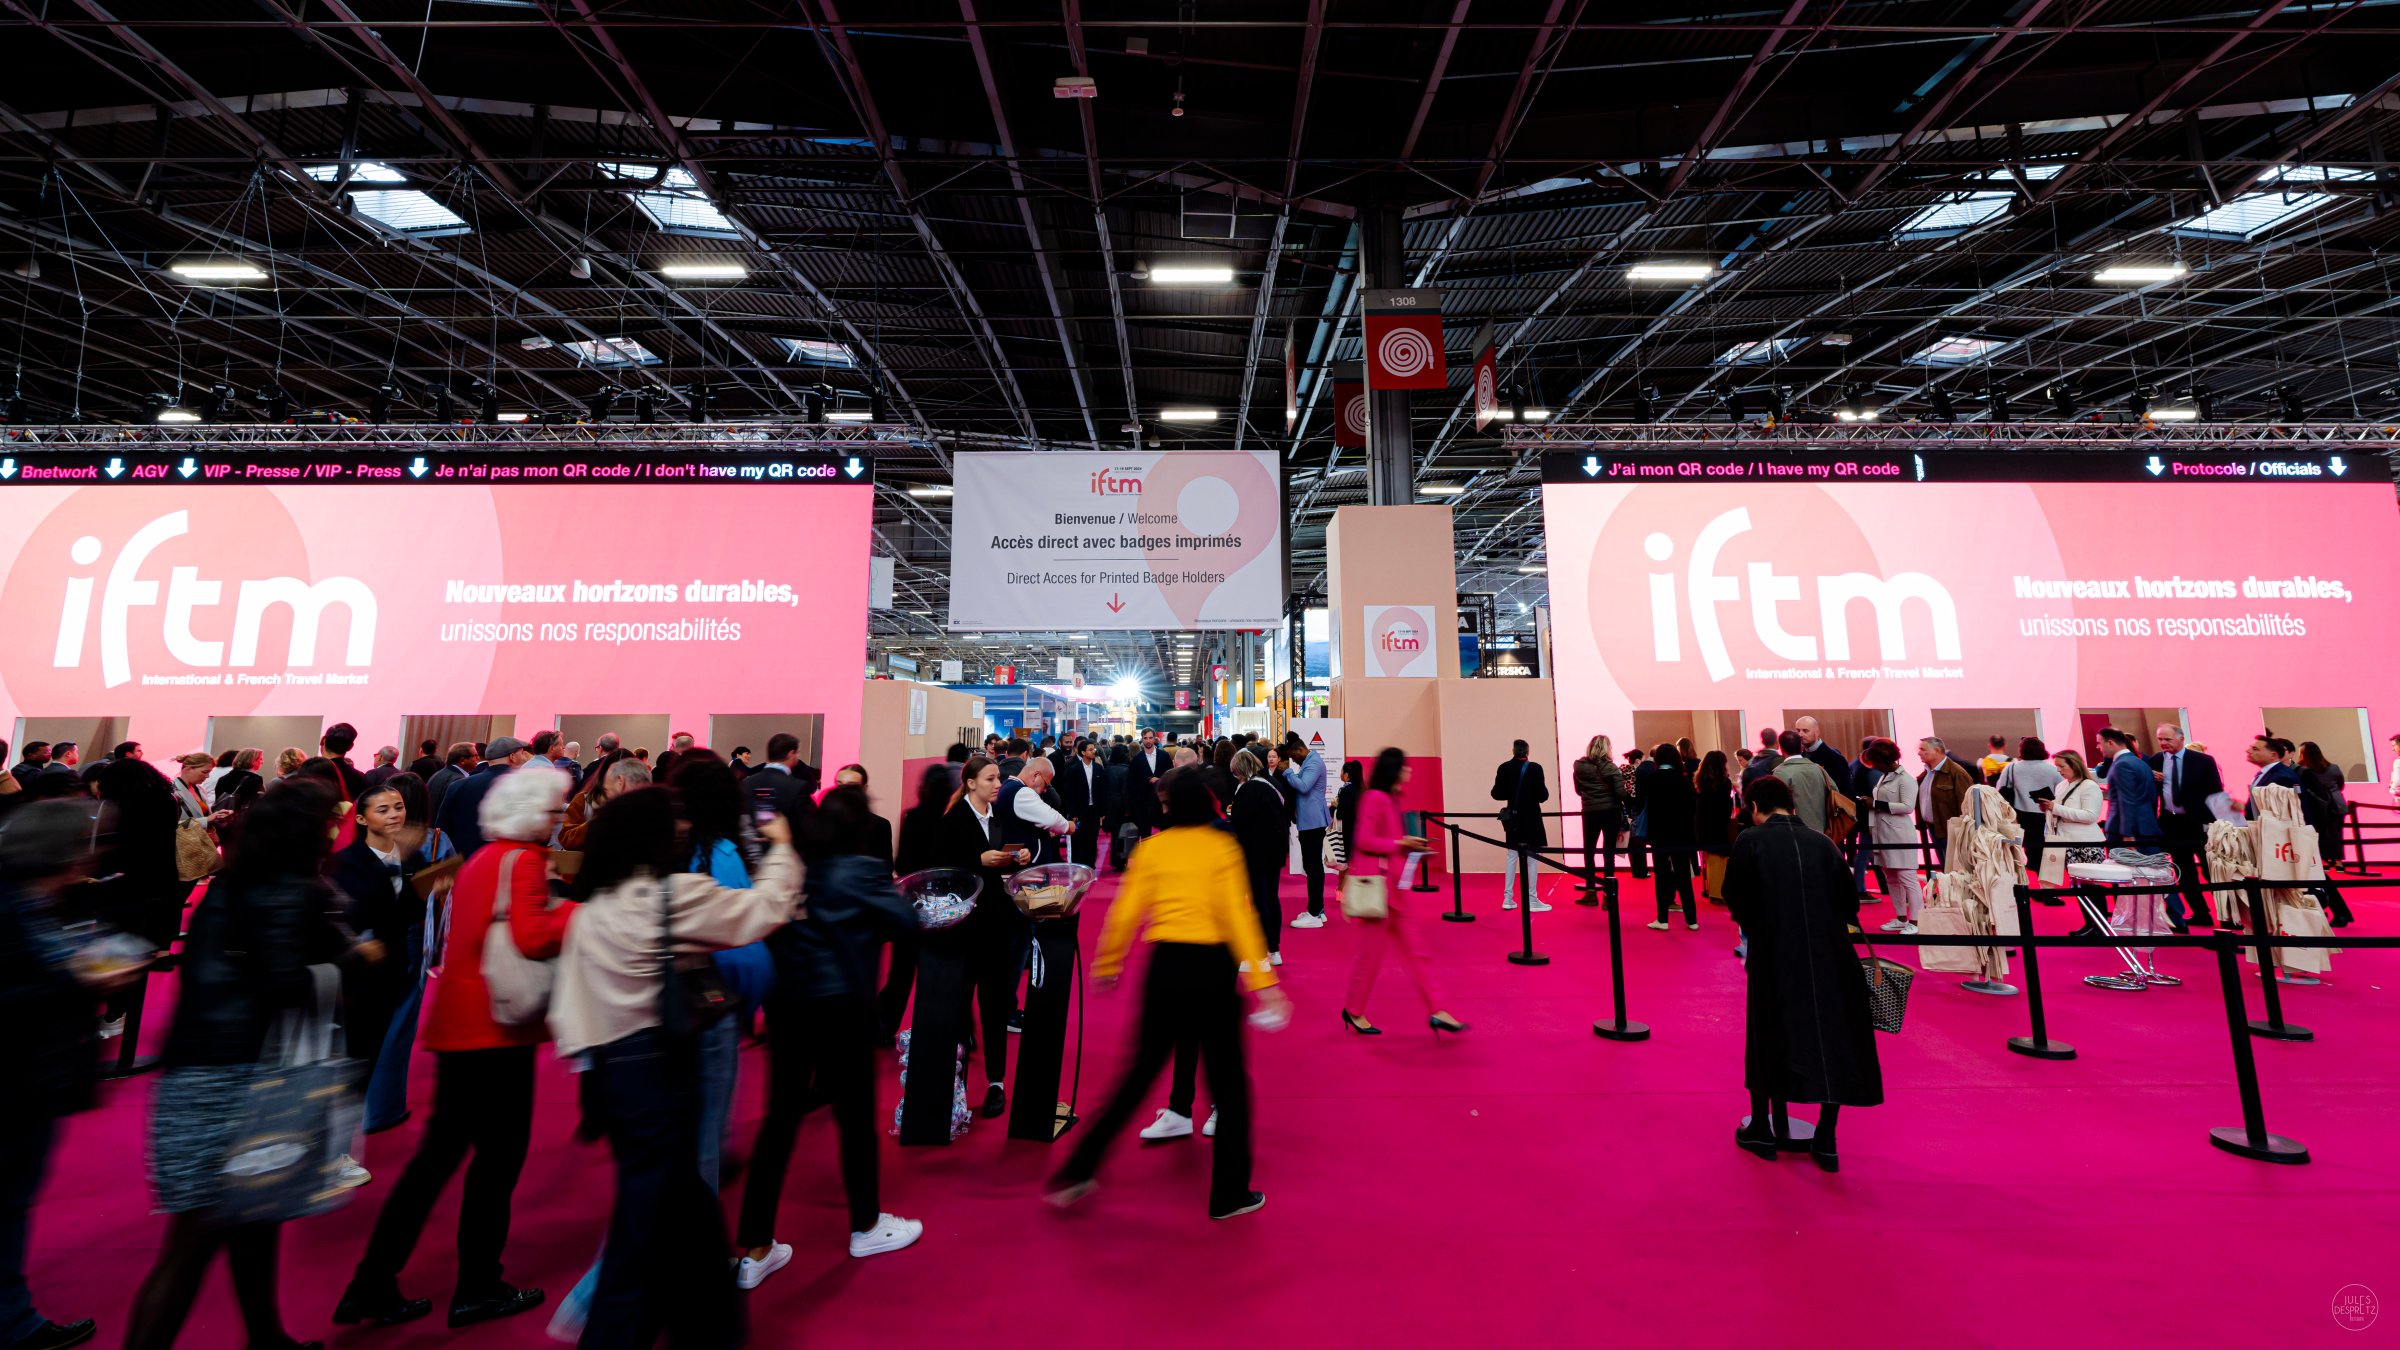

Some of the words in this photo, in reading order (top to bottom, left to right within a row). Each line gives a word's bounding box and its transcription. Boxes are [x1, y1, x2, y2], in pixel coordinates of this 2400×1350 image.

[1390, 296, 1416, 306] 1308
[21, 465, 98, 478] Bnetwork
[132, 465, 170, 478] AGV
[204, 464, 231, 478] VIP
[246, 464, 300, 478] Presse
[315, 464, 342, 478] VIP
[357, 464, 402, 478] Press
[435, 463, 455, 477] Je
[458, 463, 487, 477] n'ai
[490, 466, 520, 480] pas
[523, 466, 558, 477] mon
[562, 463, 588, 478] QR
[591, 463, 631, 477] code
[645, 463, 651, 477] I
[654, 463, 696, 477] don't
[699, 463, 737, 477] have
[740, 466, 765, 480] my
[768, 463, 793, 478] QR
[797, 463, 837, 477] code
[1639, 465, 1674, 476] mon
[1678, 462, 1702, 476] QR
[1706, 462, 1744, 476] code
[1758, 462, 1764, 476] I
[1767, 462, 1803, 476] have
[1807, 465, 1831, 478] my
[1834, 462, 1859, 476] QR
[1862, 462, 1900, 476] code
[2171, 462, 2247, 476] Protocole
[2259, 462, 2323, 476] Officials
[1091, 467, 1142, 496] iftm
[1055, 513, 1116, 525] Bienvenue
[1127, 512, 1178, 525] Welcome
[991, 534, 1034, 549] Accès
[1037, 535, 1079, 549] direct
[1083, 537, 1116, 549] avec
[1120, 534, 1171, 551] badges
[1175, 533, 1242, 551] imprimés
[1007, 572, 1041, 585] Direct
[1043, 572, 1077, 584] Acces
[1080, 571, 1096, 584] for
[1099, 571, 1139, 584] Printed
[1143, 571, 1179, 586] Badge
[1182, 571, 1225, 584] Holders
[445, 579, 566, 603] Nouveaux
[573, 579, 678, 603] horizons
[685, 579, 799, 607] durables,
[1644, 506, 1963, 682] iftm
[2013, 576, 2131, 600] Nouveaux
[2135, 575, 2237, 599] horizons
[2243, 575, 2353, 603] durables,
[53, 509, 378, 689] iftm
[441, 618, 534, 642] unissons
[540, 622, 578, 642] nos
[584, 617, 741, 646] responsabilités
[2020, 614, 2110, 638] unissons
[2114, 617, 2152, 637] nos
[2157, 612, 2306, 641] responsabilités
[1381, 630, 1419, 652] iftm
[142, 674, 222, 685] International
[224, 674, 234, 685] &
[237, 674, 282, 685] French
[285, 674, 323, 685] Travel
[326, 674, 369, 685] Market
[1746, 668, 1822, 679] International
[1825, 667, 1835, 679] &
[1838, 667, 1880, 679] French
[1883, 667, 1920, 679] Travel
[1922, 667, 1964, 679] Market
